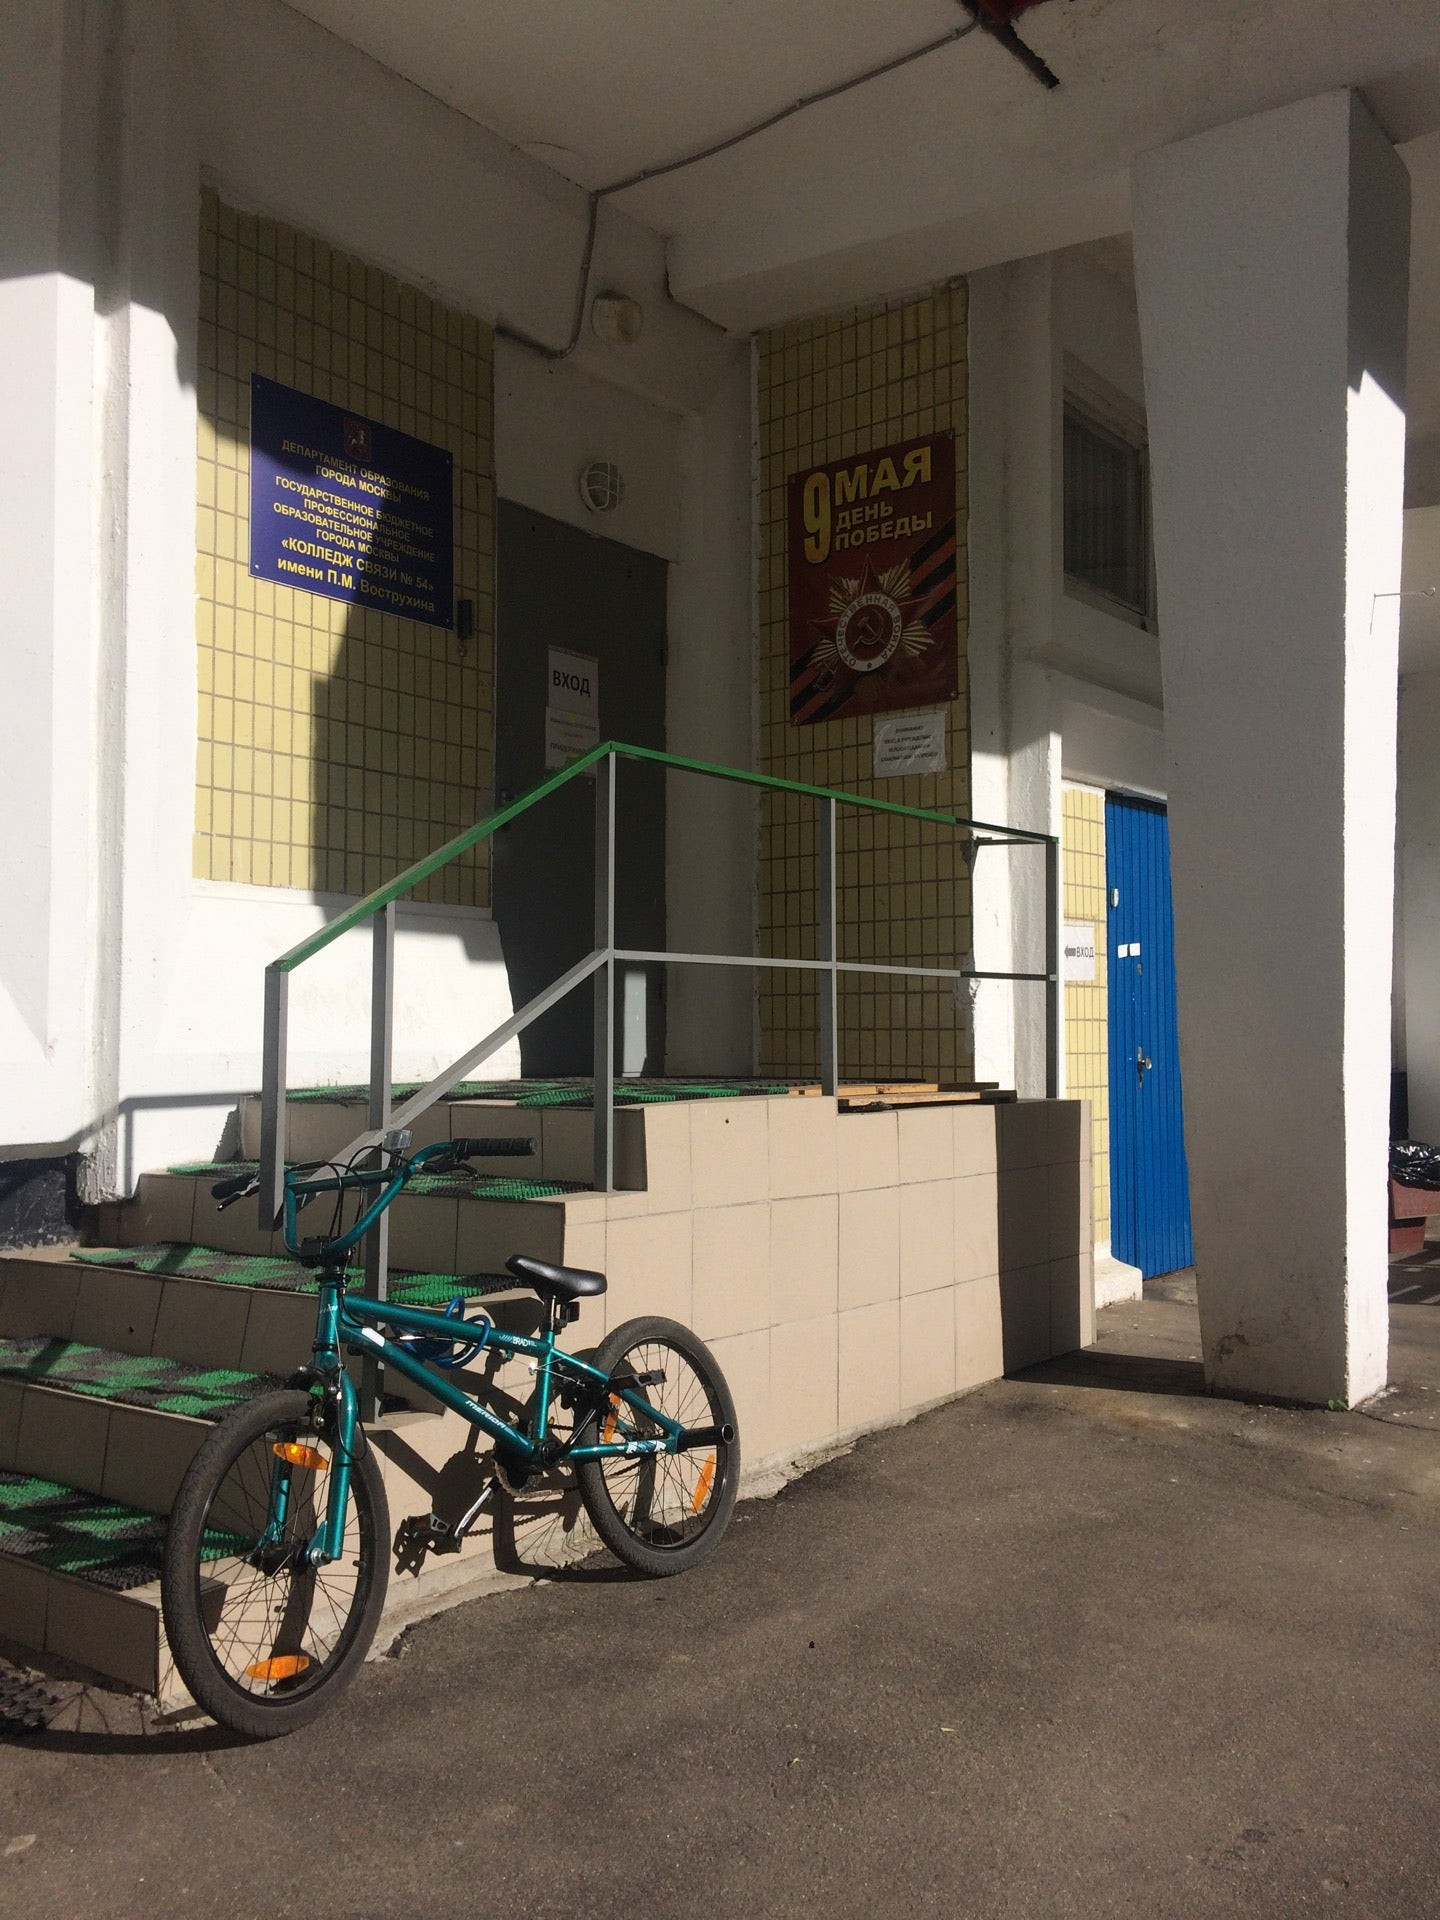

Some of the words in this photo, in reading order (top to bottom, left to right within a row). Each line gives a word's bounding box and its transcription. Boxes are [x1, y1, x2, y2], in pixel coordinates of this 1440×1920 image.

[282, 440, 357, 475] ДЕПАРТАМЕНТ
[360, 469, 429, 500] ОБРАЗОВАНИЯ
[315, 466, 356, 488] ГОРОДА
[359, 481, 401, 503] МОСКВЫ
[276, 476, 373, 517] ГОСУДАРСТВЕННОЕ
[376, 510, 433, 538] БЮДЖЕТНОЕ
[304, 499, 410, 542] ПРОФЕССИОНАЛЬНОЕ
[803, 472, 831, 564] 9
[834, 445, 932, 506] МАЯ
[836, 499, 893, 533] ДЕНЬ
[274, 503, 373, 542] ОБРАЗОВАТЕЛЬНОЕ
[375, 534, 435, 562] УЧРЕЖДЕНИЕ
[316, 529, 356, 552] ГОРОДА
[358, 543, 399, 563] МОСКВЫ
[835, 512, 932, 551] ПОБЕДЫ
[278, 558, 323, 580] имени
[327, 569, 356, 590] П.М.
[361, 579, 435, 612] Вострухина
[282, 538, 353, 568] «КОЛЛЕДЖ
[356, 558, 396, 581] СВЯЗИ
[401, 570, 414, 583] №
[415, 575, 433, 591] 54»
[837, 595, 897, 666] ОТЕЧЕСТВЕННАЯ
[881, 615, 901, 660] ВОЙНА
[553, 670, 591, 698] ВХОД
[1077, 947, 1094, 960] ВХОД
[465, 1400, 506, 1428] MERIDA
